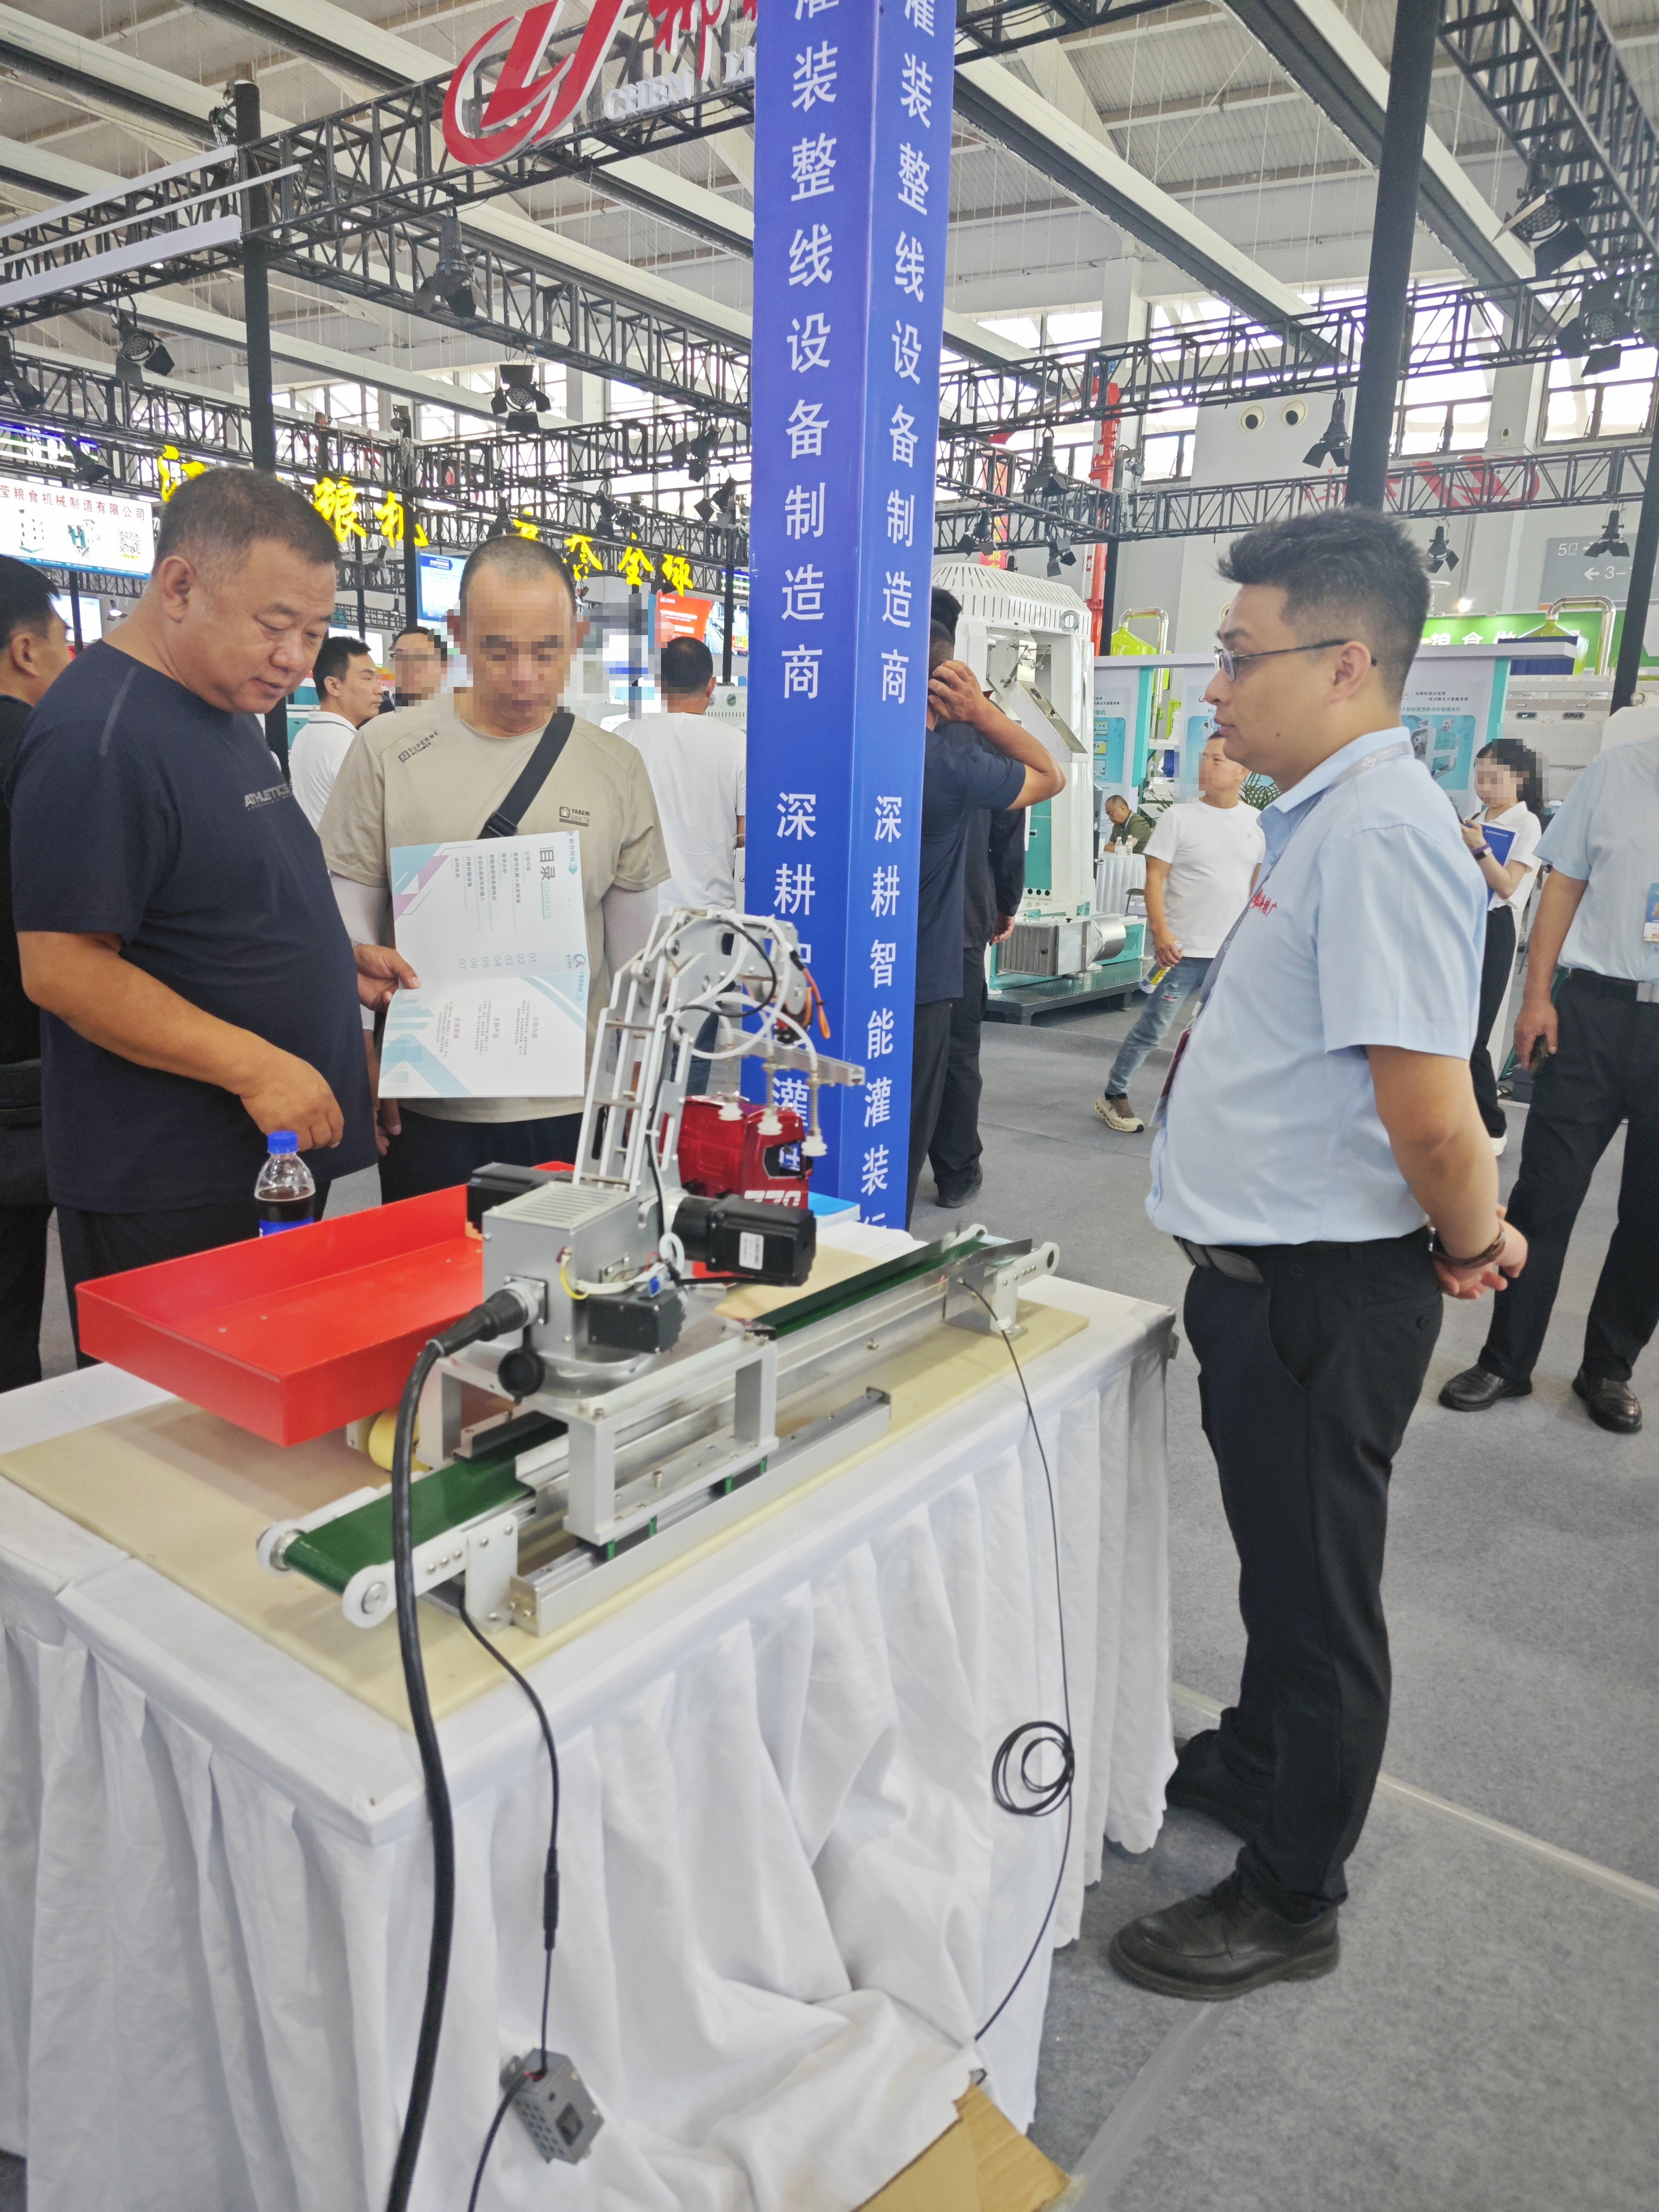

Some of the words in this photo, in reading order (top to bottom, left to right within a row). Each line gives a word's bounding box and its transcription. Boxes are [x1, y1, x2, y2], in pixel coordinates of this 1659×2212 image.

[603, 67, 696, 121] CHEN
[408, 730, 439, 752] SUPERME
[539, 849, 555, 881] 目录
[543, 881, 551, 919] CONTENTS
[470, 958, 478, 969] 06
[482, 957, 490, 968] 05
[494, 956, 501, 967] 04
[505, 955, 513, 966] 03
[517, 954, 525, 965] 02
[529, 953, 537, 963] 01
[458, 959, 467, 969] 07
